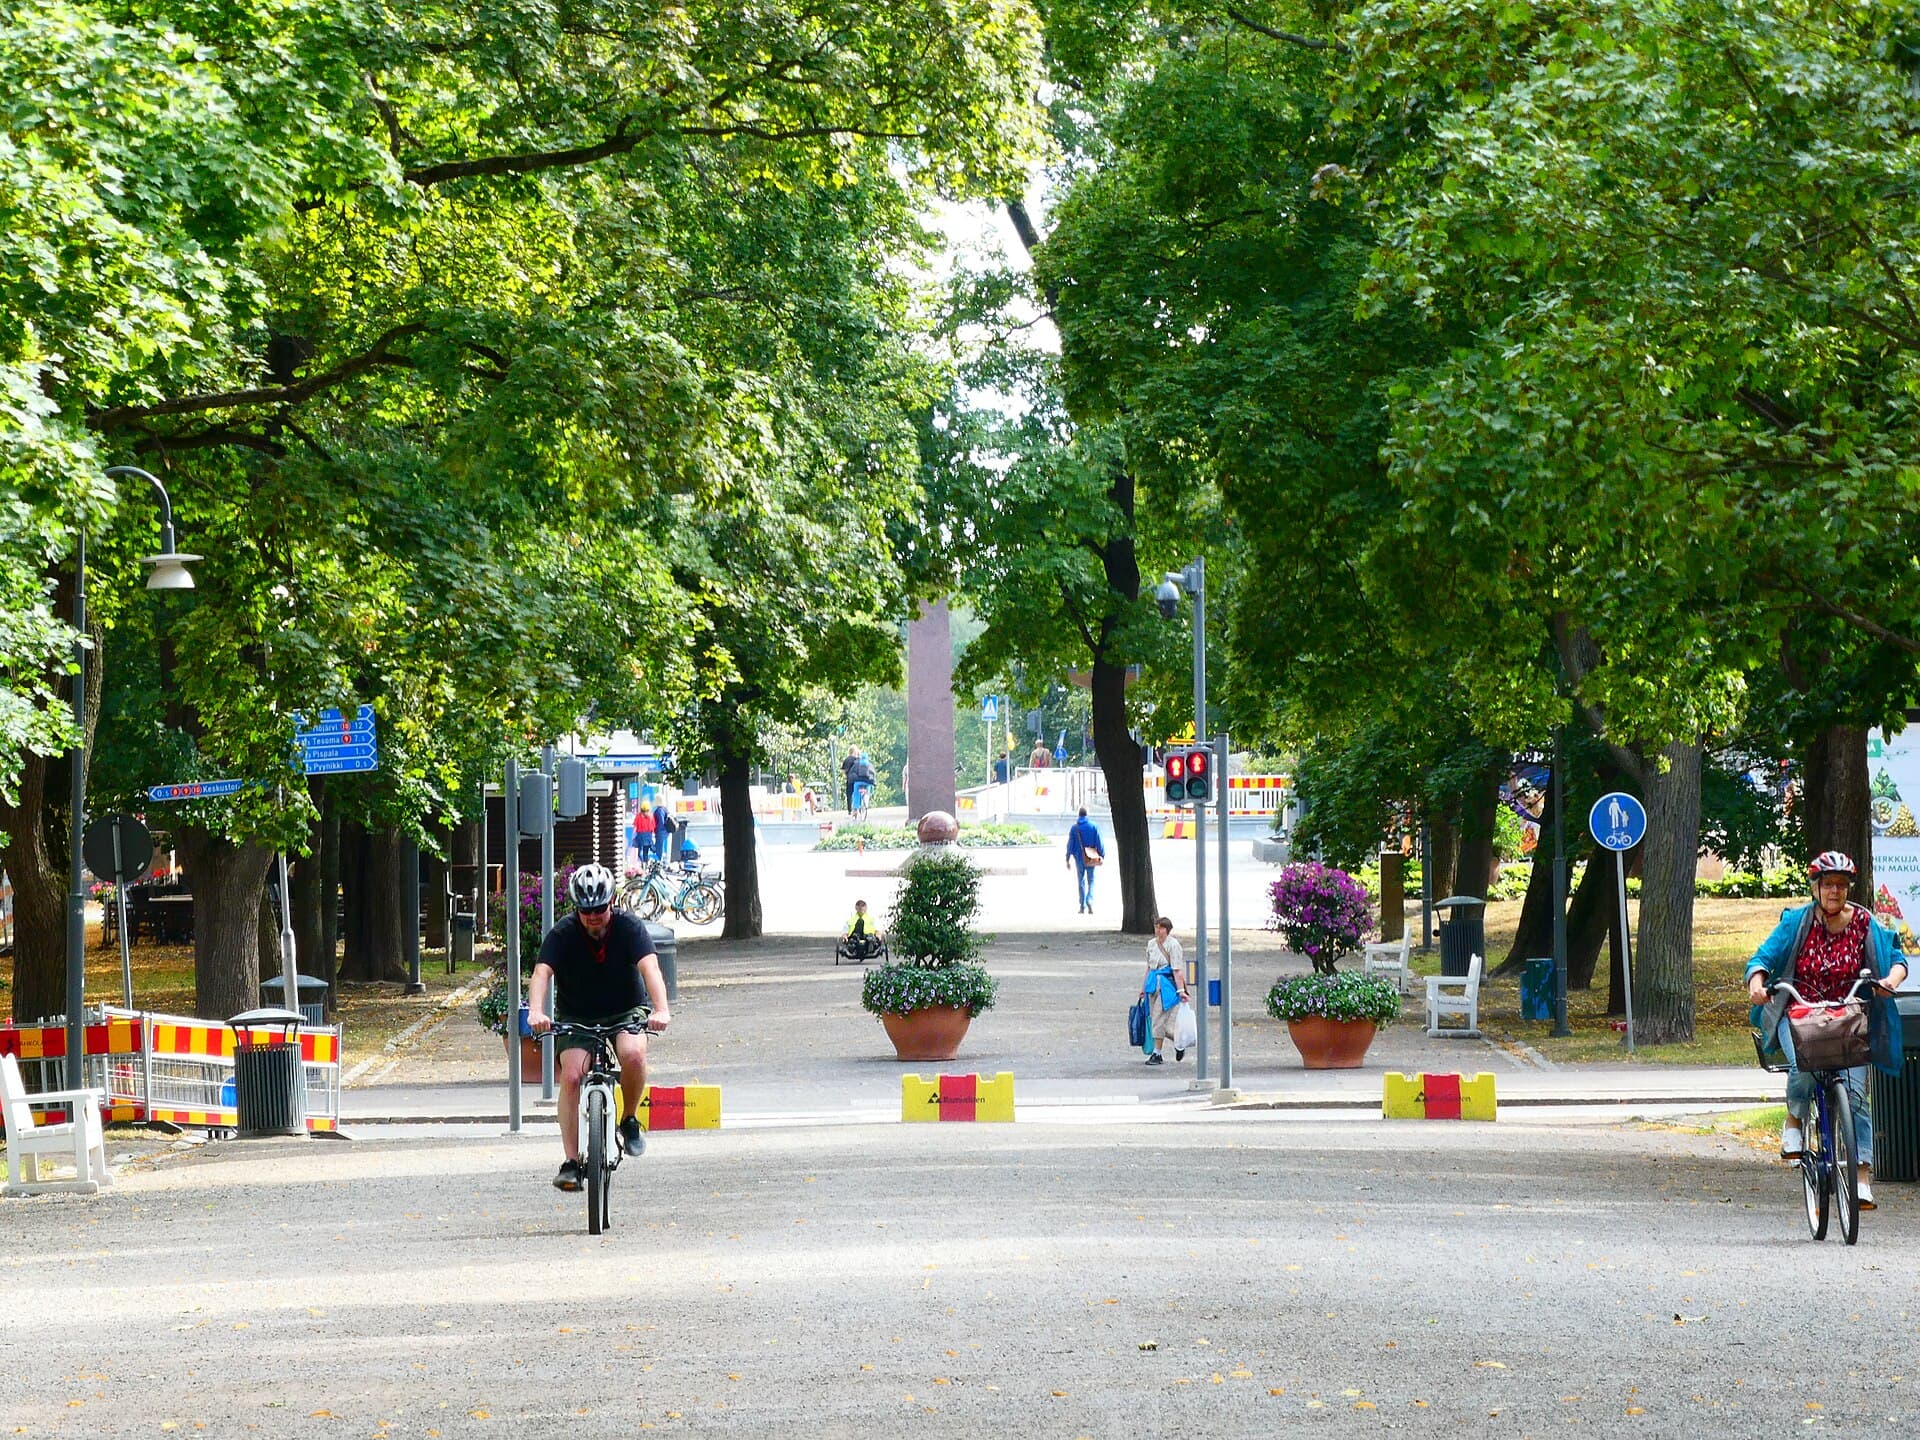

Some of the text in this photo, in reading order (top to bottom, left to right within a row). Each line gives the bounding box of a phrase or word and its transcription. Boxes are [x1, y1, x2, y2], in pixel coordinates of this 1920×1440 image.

[312, 736, 340, 744] Tesoma
[312, 749, 339, 758] Pispala
[313, 761, 343, 771] Pyynikki
